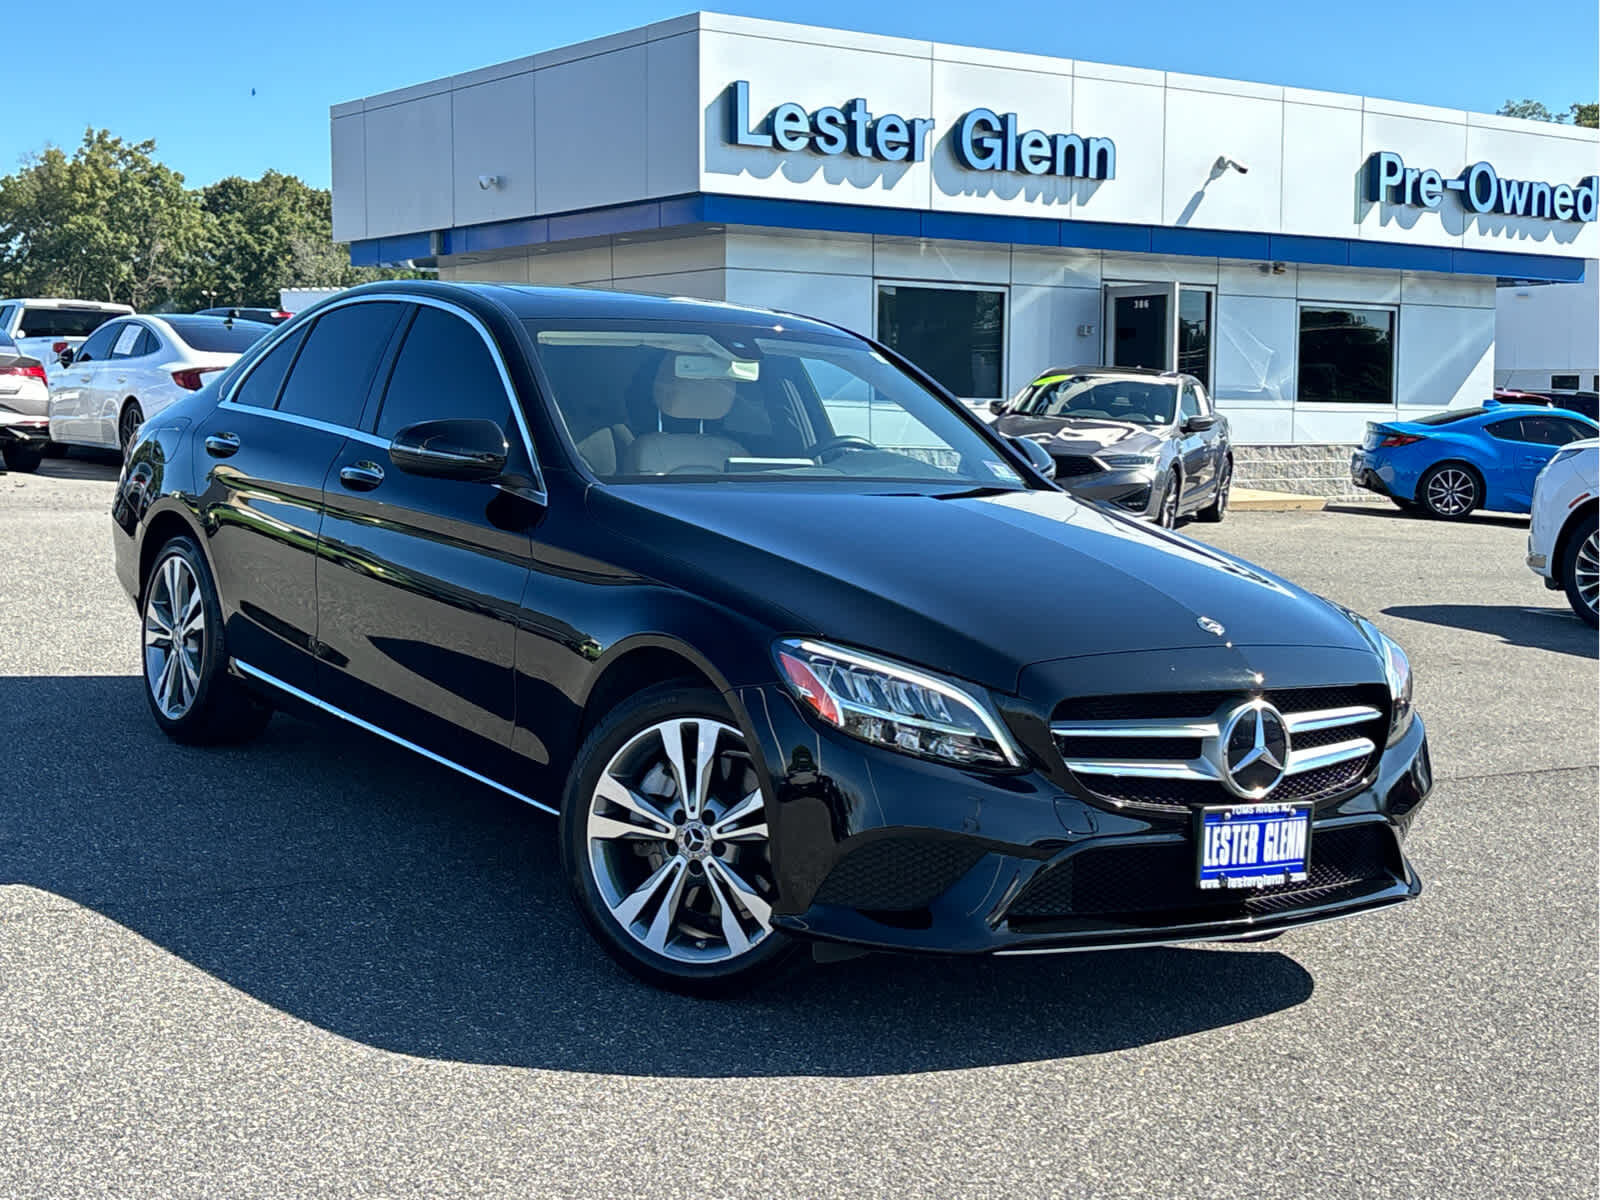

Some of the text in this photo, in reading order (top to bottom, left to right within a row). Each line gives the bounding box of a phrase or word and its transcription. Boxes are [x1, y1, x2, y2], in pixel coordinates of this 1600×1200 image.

[731, 80, 1116, 181] Lester Glenn
[1370, 151, 1599, 222] Pre-Owned
[1203, 819, 1307, 867] LESTER GLENN
